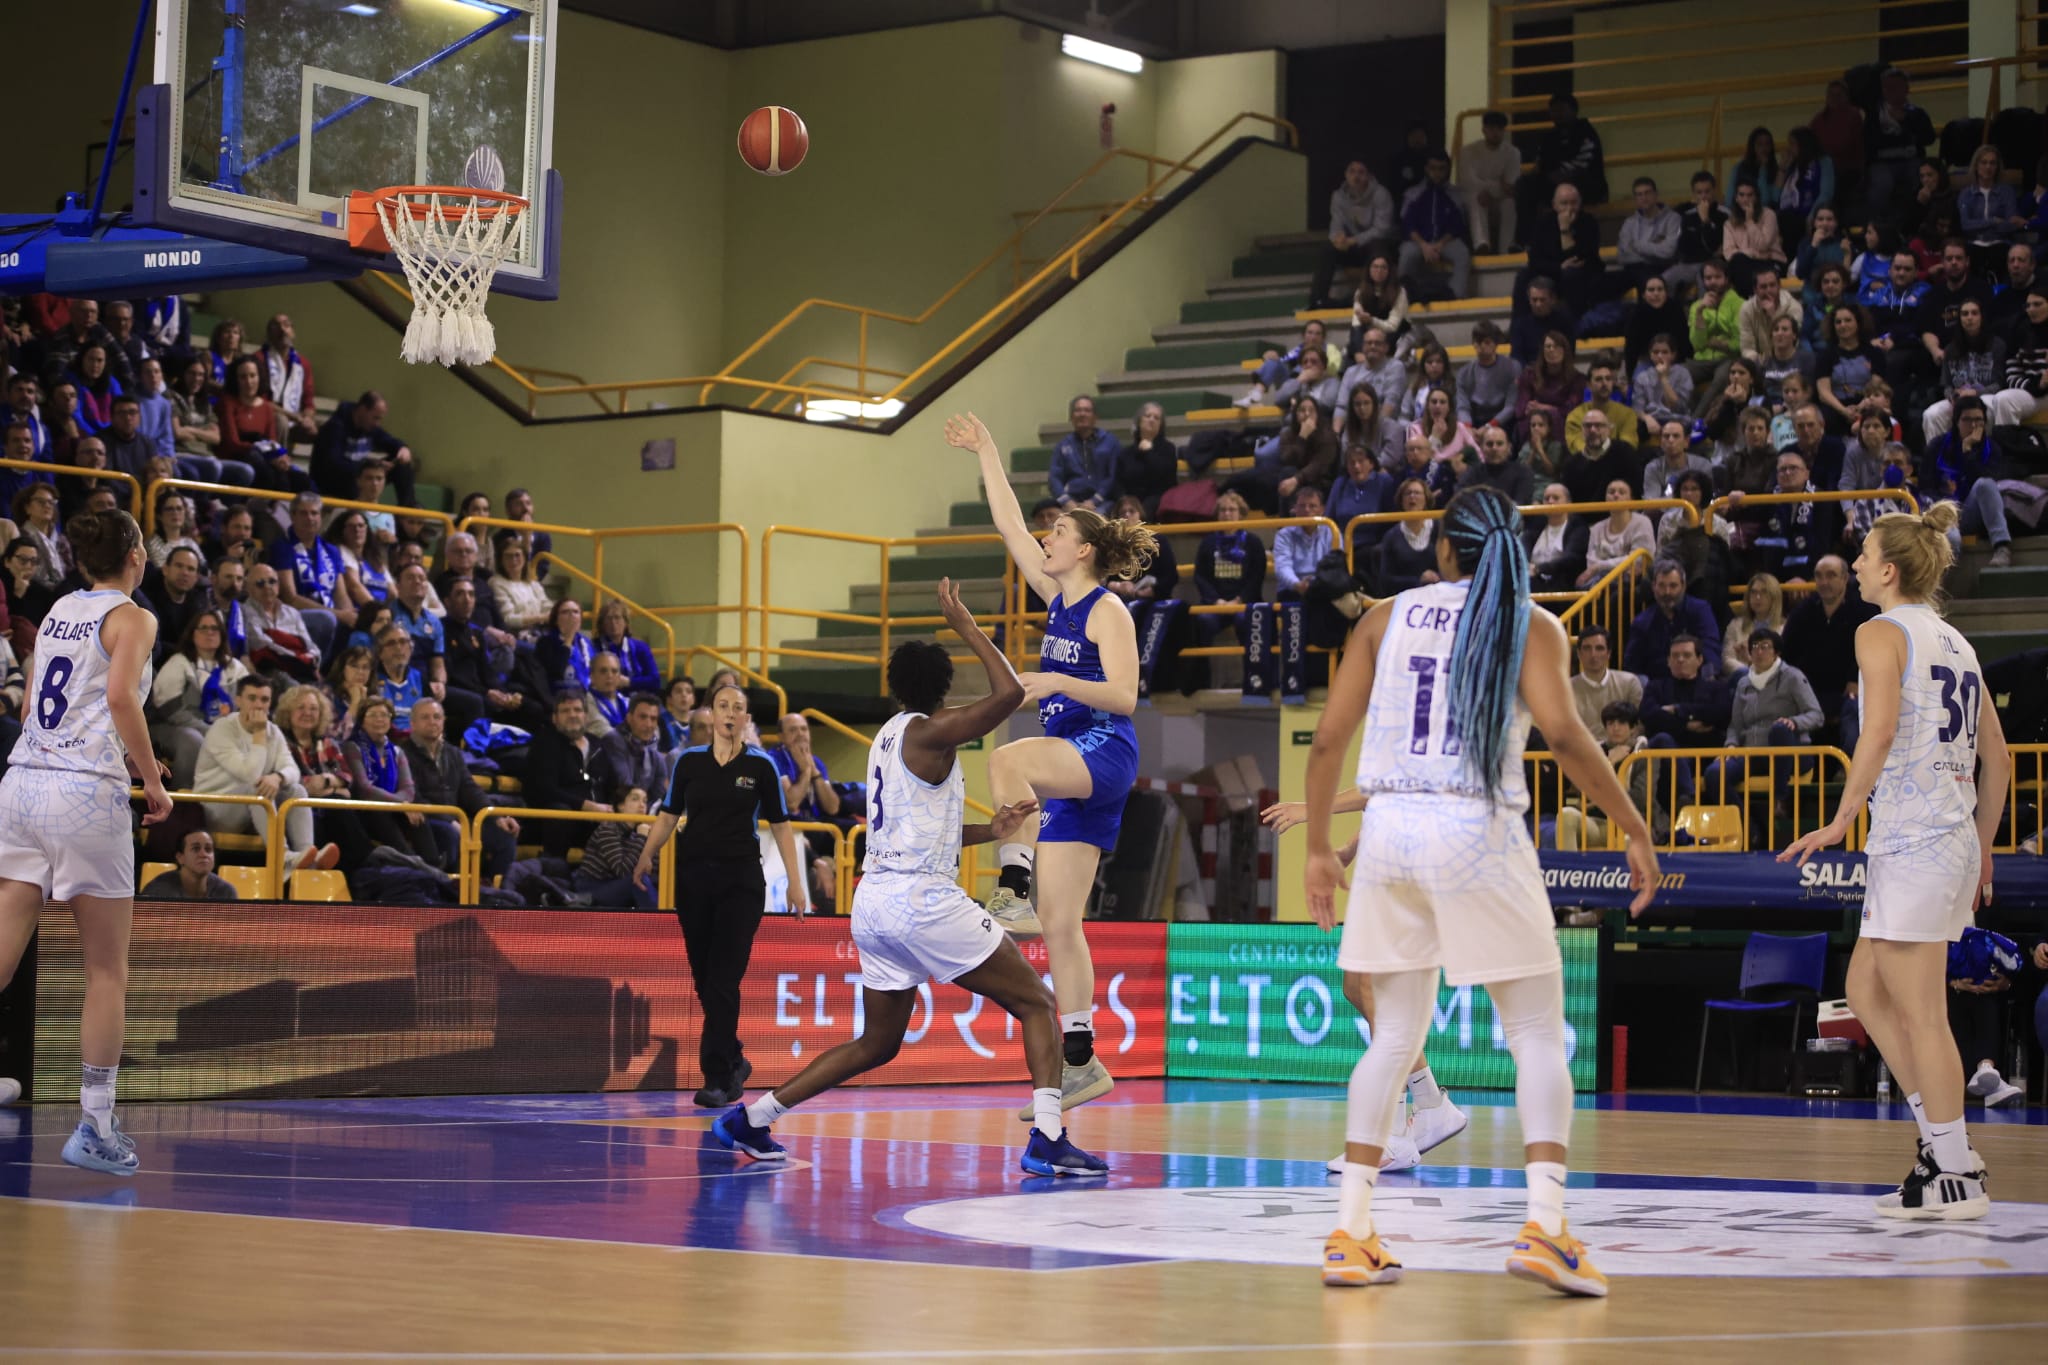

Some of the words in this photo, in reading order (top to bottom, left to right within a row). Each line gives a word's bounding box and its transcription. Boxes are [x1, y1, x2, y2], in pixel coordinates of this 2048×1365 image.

[144, 250, 201, 268] MONDO
[1287, 607, 1300, 662] basket
[37, 655, 74, 730] 8
[1930, 664, 1981, 749] 30
[1229, 943, 1297, 964] CENTRO
